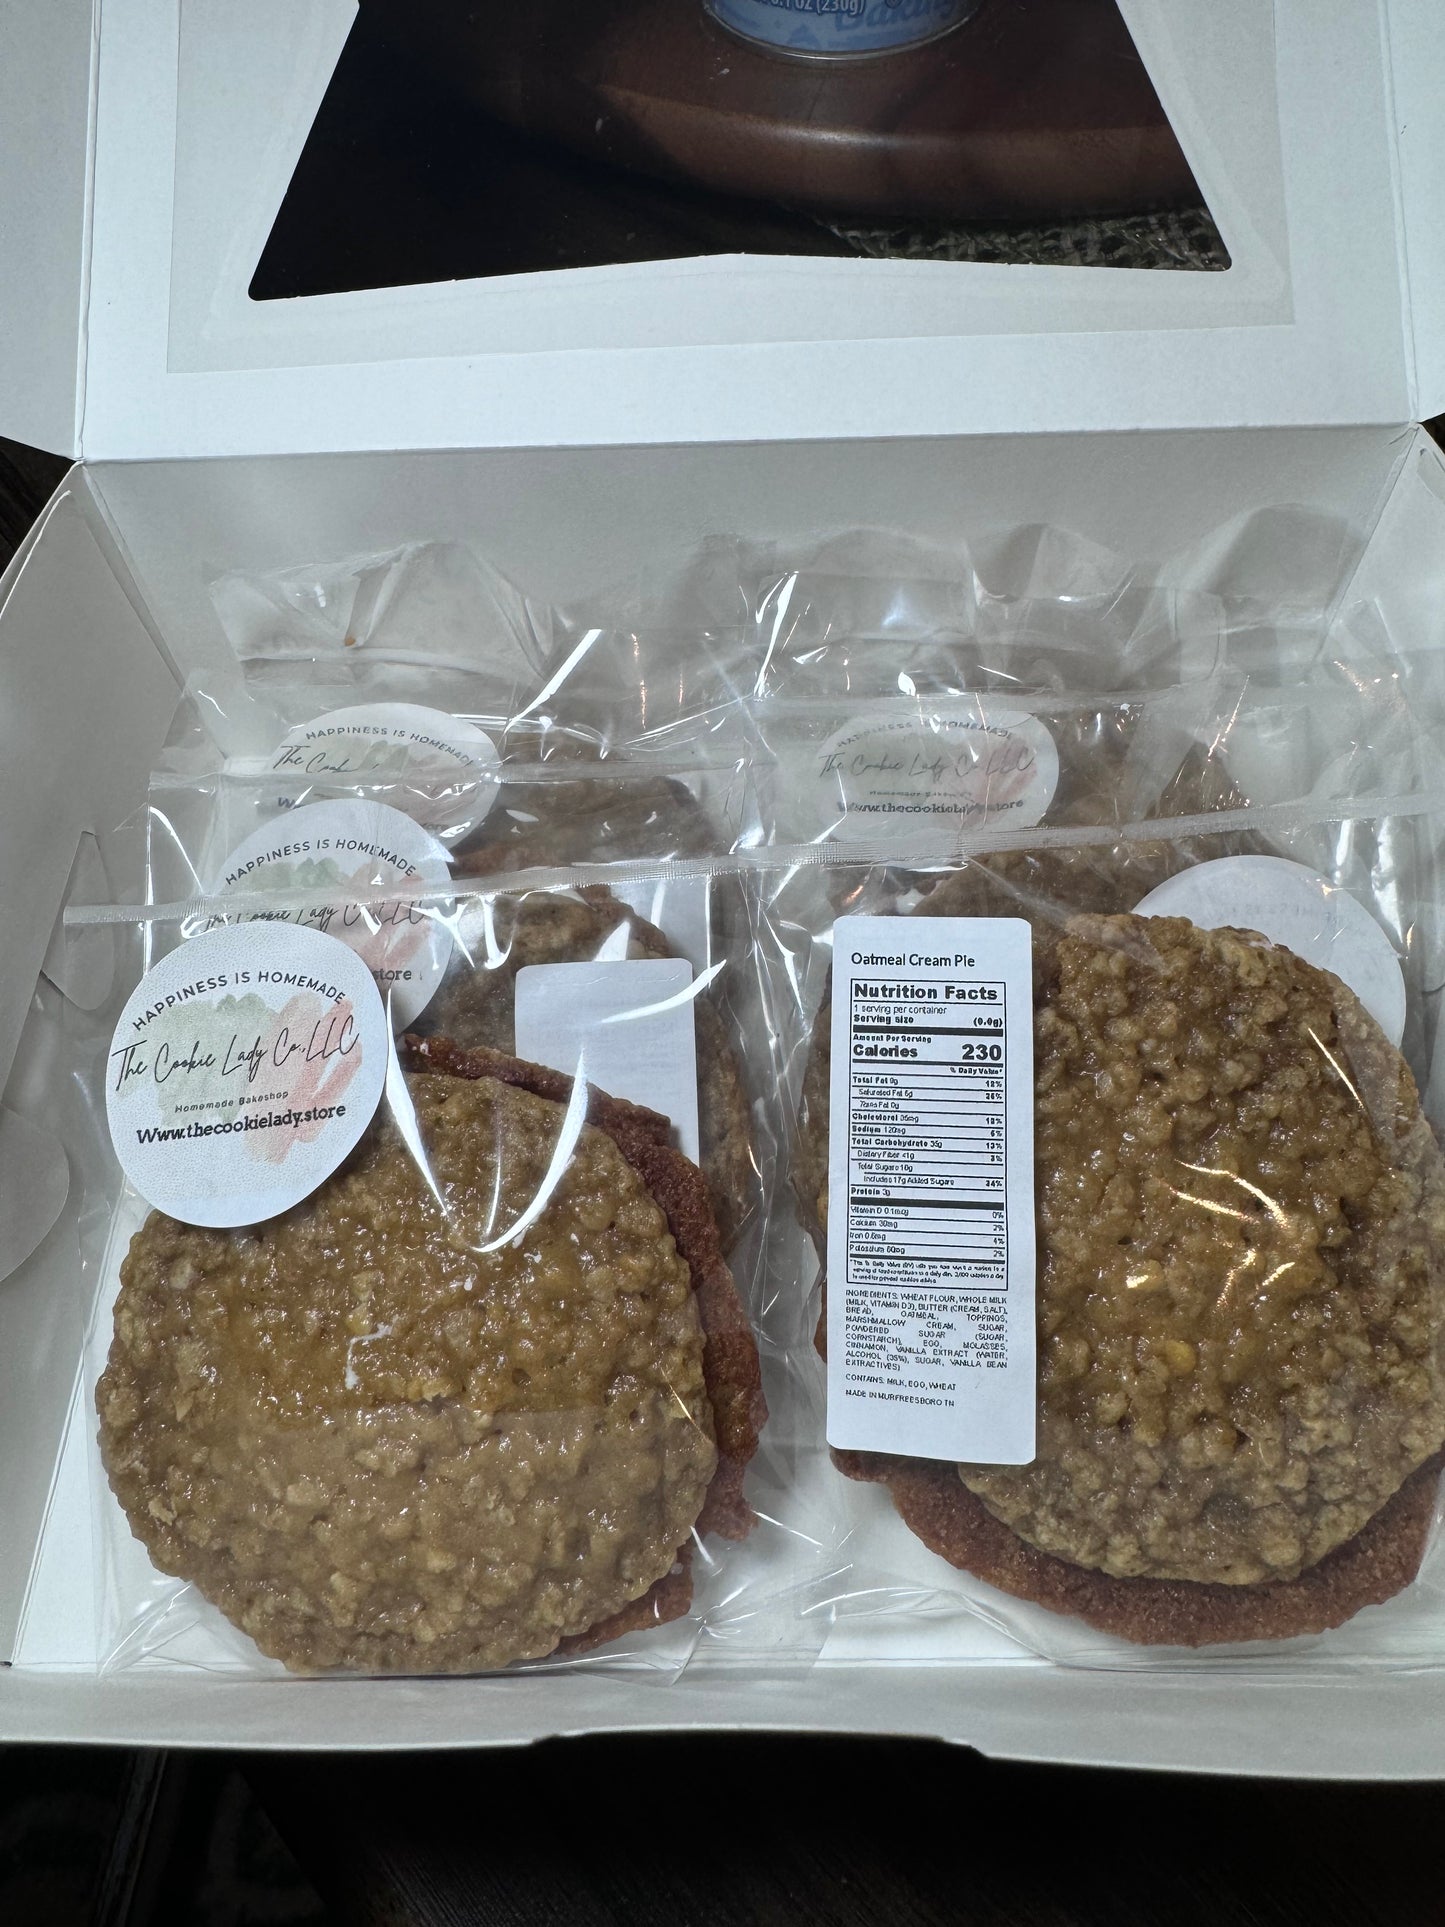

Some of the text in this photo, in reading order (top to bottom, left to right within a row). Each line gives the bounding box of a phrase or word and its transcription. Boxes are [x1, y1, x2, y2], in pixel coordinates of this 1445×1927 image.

[306, 727, 388, 740] HAPPINESS
[393, 729, 405, 737] IS
[273, 745, 311, 769] The
[225, 841, 311, 886] HAPPINESS
[316, 839, 330, 850] IS
[851, 952, 975, 967] Oatmeal Cream Pie
[854, 983, 998, 1000] Nutrition Facts
[132, 975, 228, 1032] HAPPINESS
[235, 971, 250, 983] IS
[258, 971, 346, 1005] HOMEMADE
[862, 1005, 891, 1014] serving
[894, 1006, 906, 1014] per
[909, 1006, 947, 1014] container
[854, 1014, 891, 1025] Serving
[895, 1015, 914, 1023] size
[853, 1034, 884, 1042] Amount
[853, 1044, 1001, 1061] Calories 230
[112, 1039, 148, 1091] The
[154, 1041, 216, 1083] Cookie
[222, 1034, 269, 1083] Lady
[959, 1067, 977, 1075] Daily
[853, 1076, 873, 1084] Total
[875, 1076, 889, 1084] Fat
[175, 1091, 289, 1113] Homemade Bakeshop
[852, 1113, 898, 1122] Cholesterol
[137, 1105, 346, 1144] Www.thecookielady.store
[852, 1125, 881, 1134] Sodium
[852, 1137, 872, 1146] Total
[874, 1138, 928, 1148] Carbohydrate
[857, 1150, 882, 1159] Dietary
[875, 1163, 899, 1172] Sugars
[864, 1175, 892, 1184] Includes
[907, 1177, 929, 1185] Added
[930, 1178, 954, 1186] Sugars
[851, 1187, 880, 1195] Protein
[850, 1245, 884, 1253] Potassium
[900, 1293, 927, 1301] WHEAT
[959, 1296, 987, 1304] WHOLE
[870, 1300, 899, 1309] VITAMIN
[918, 1304, 948, 1312] BUTTER
[846, 1315, 906, 1327] MARSHMALLOW
[846, 1325, 889, 1334] POWDERED
[918, 1330, 945, 1338] SUGAR
[896, 1345, 926, 1355] VANILLA
[933, 1349, 968, 1357] EXTRACT
[846, 1351, 881, 1360] ALCOHOL
[950, 1360, 981, 1368] VANILLA
[987, 1361, 1007, 1369] BEAN
[929, 1382, 956, 1391] WHEAT
[846, 1389, 866, 1398] MADE
[878, 1392, 943, 1407] MURFREESBORO
